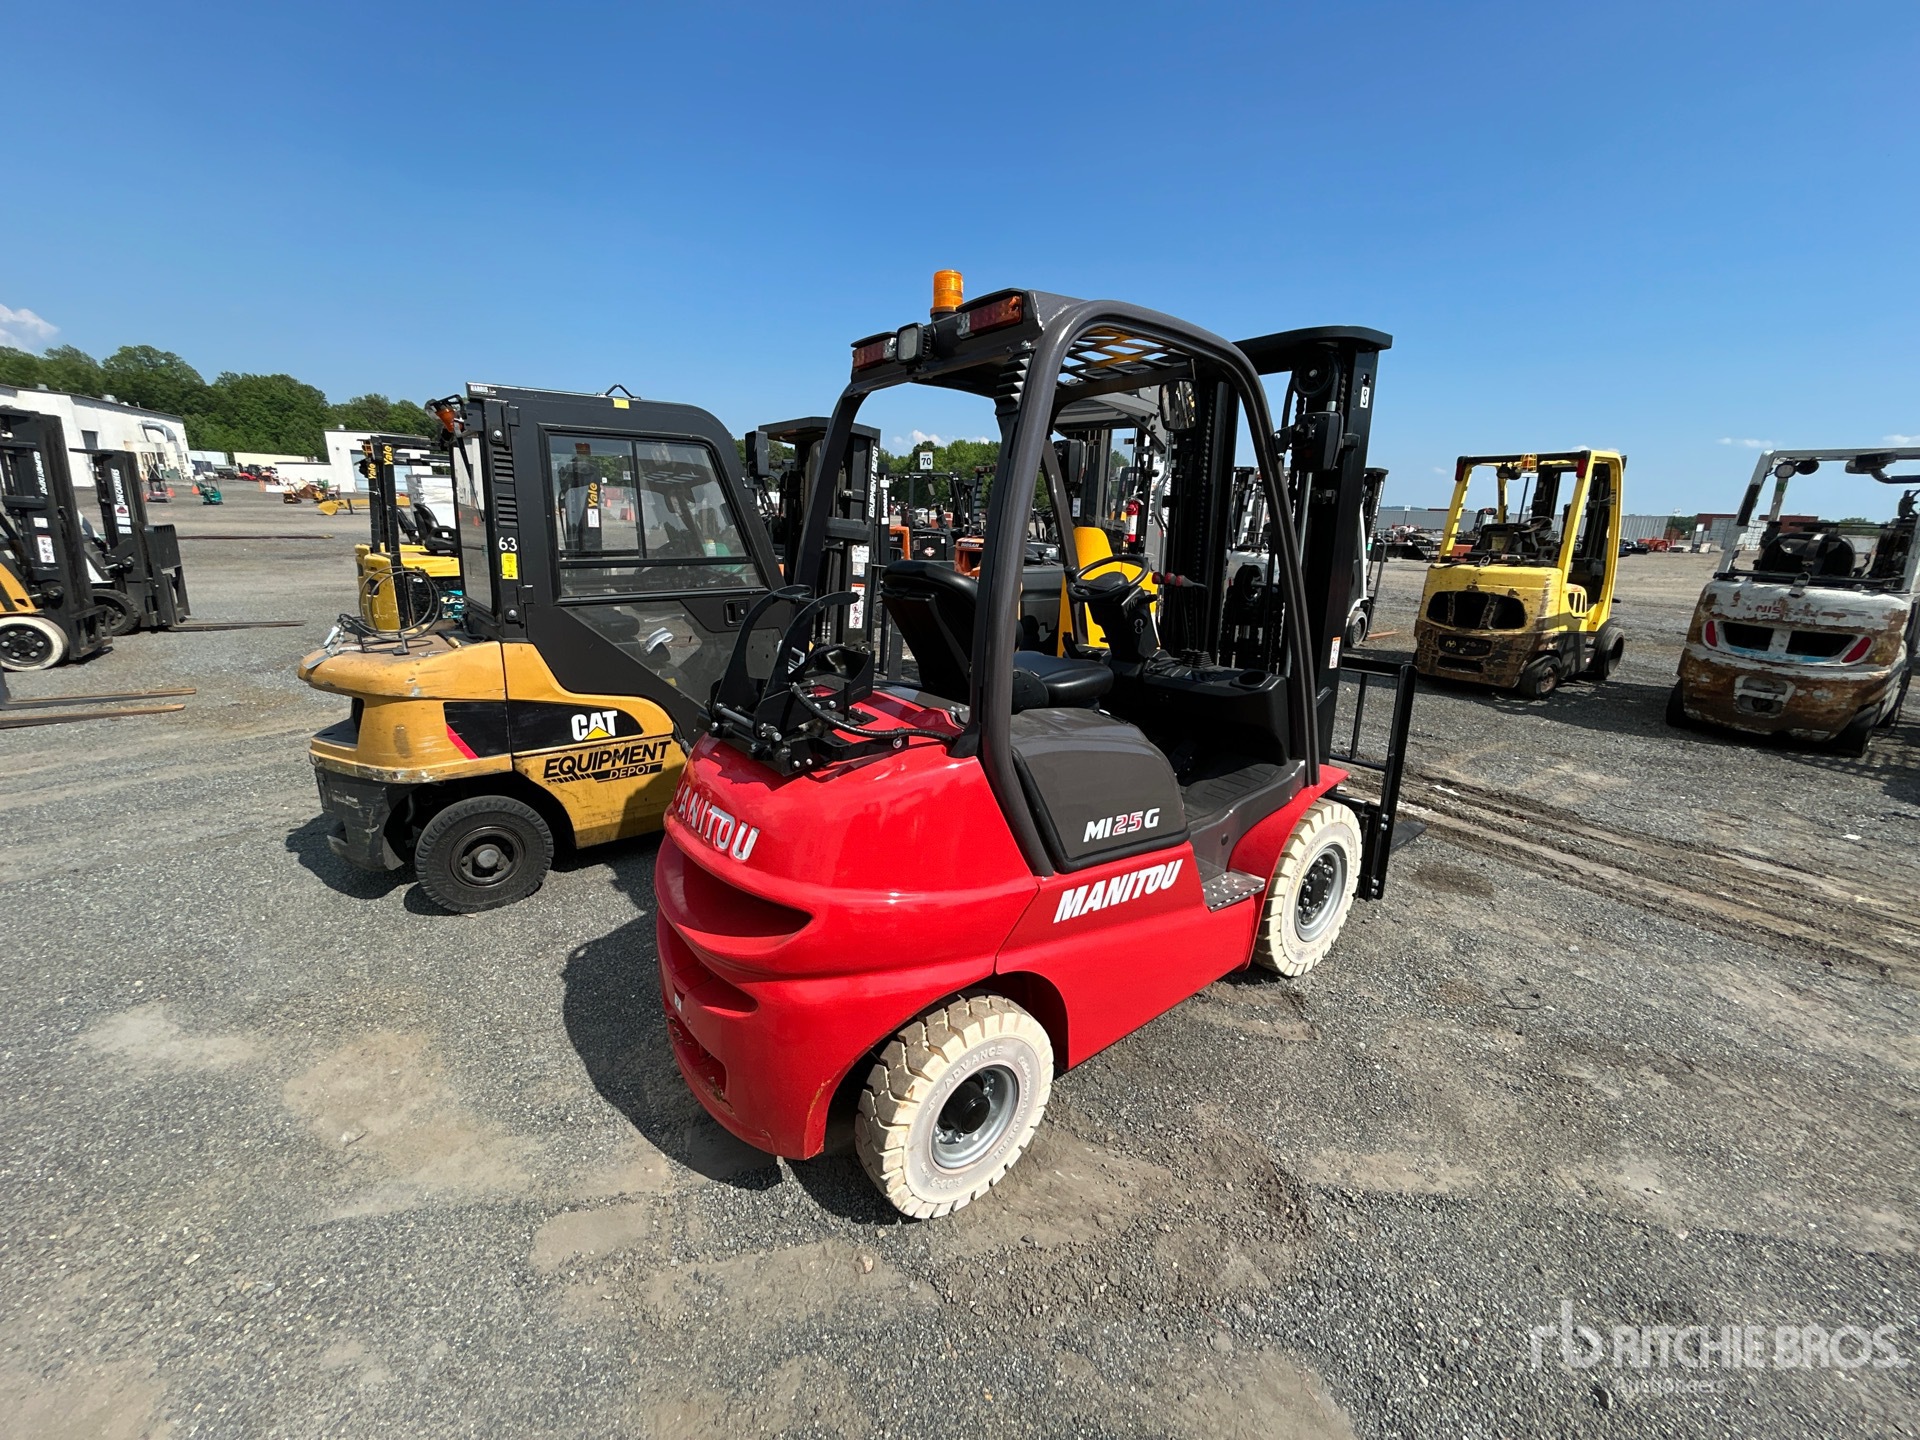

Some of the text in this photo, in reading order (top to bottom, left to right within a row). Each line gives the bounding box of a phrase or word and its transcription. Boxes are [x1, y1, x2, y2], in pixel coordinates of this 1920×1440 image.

[383, 445, 394, 465] Yale
[921, 457, 932, 466] 70
[368, 463, 376, 479] Yale
[868, 446, 879, 518] EQUIPMENT DEPOT
[588, 482, 598, 507] Yale
[498, 536, 518, 551] 63
[571, 710, 617, 741] CAT
[543, 740, 671, 780] EQUIPMENT
[609, 765, 651, 779] DEPOT
[1083, 807, 1160, 842] MI25G
[1053, 858, 1183, 923] MANITOU
[944, 1045, 1004, 1089] ADVANCE
